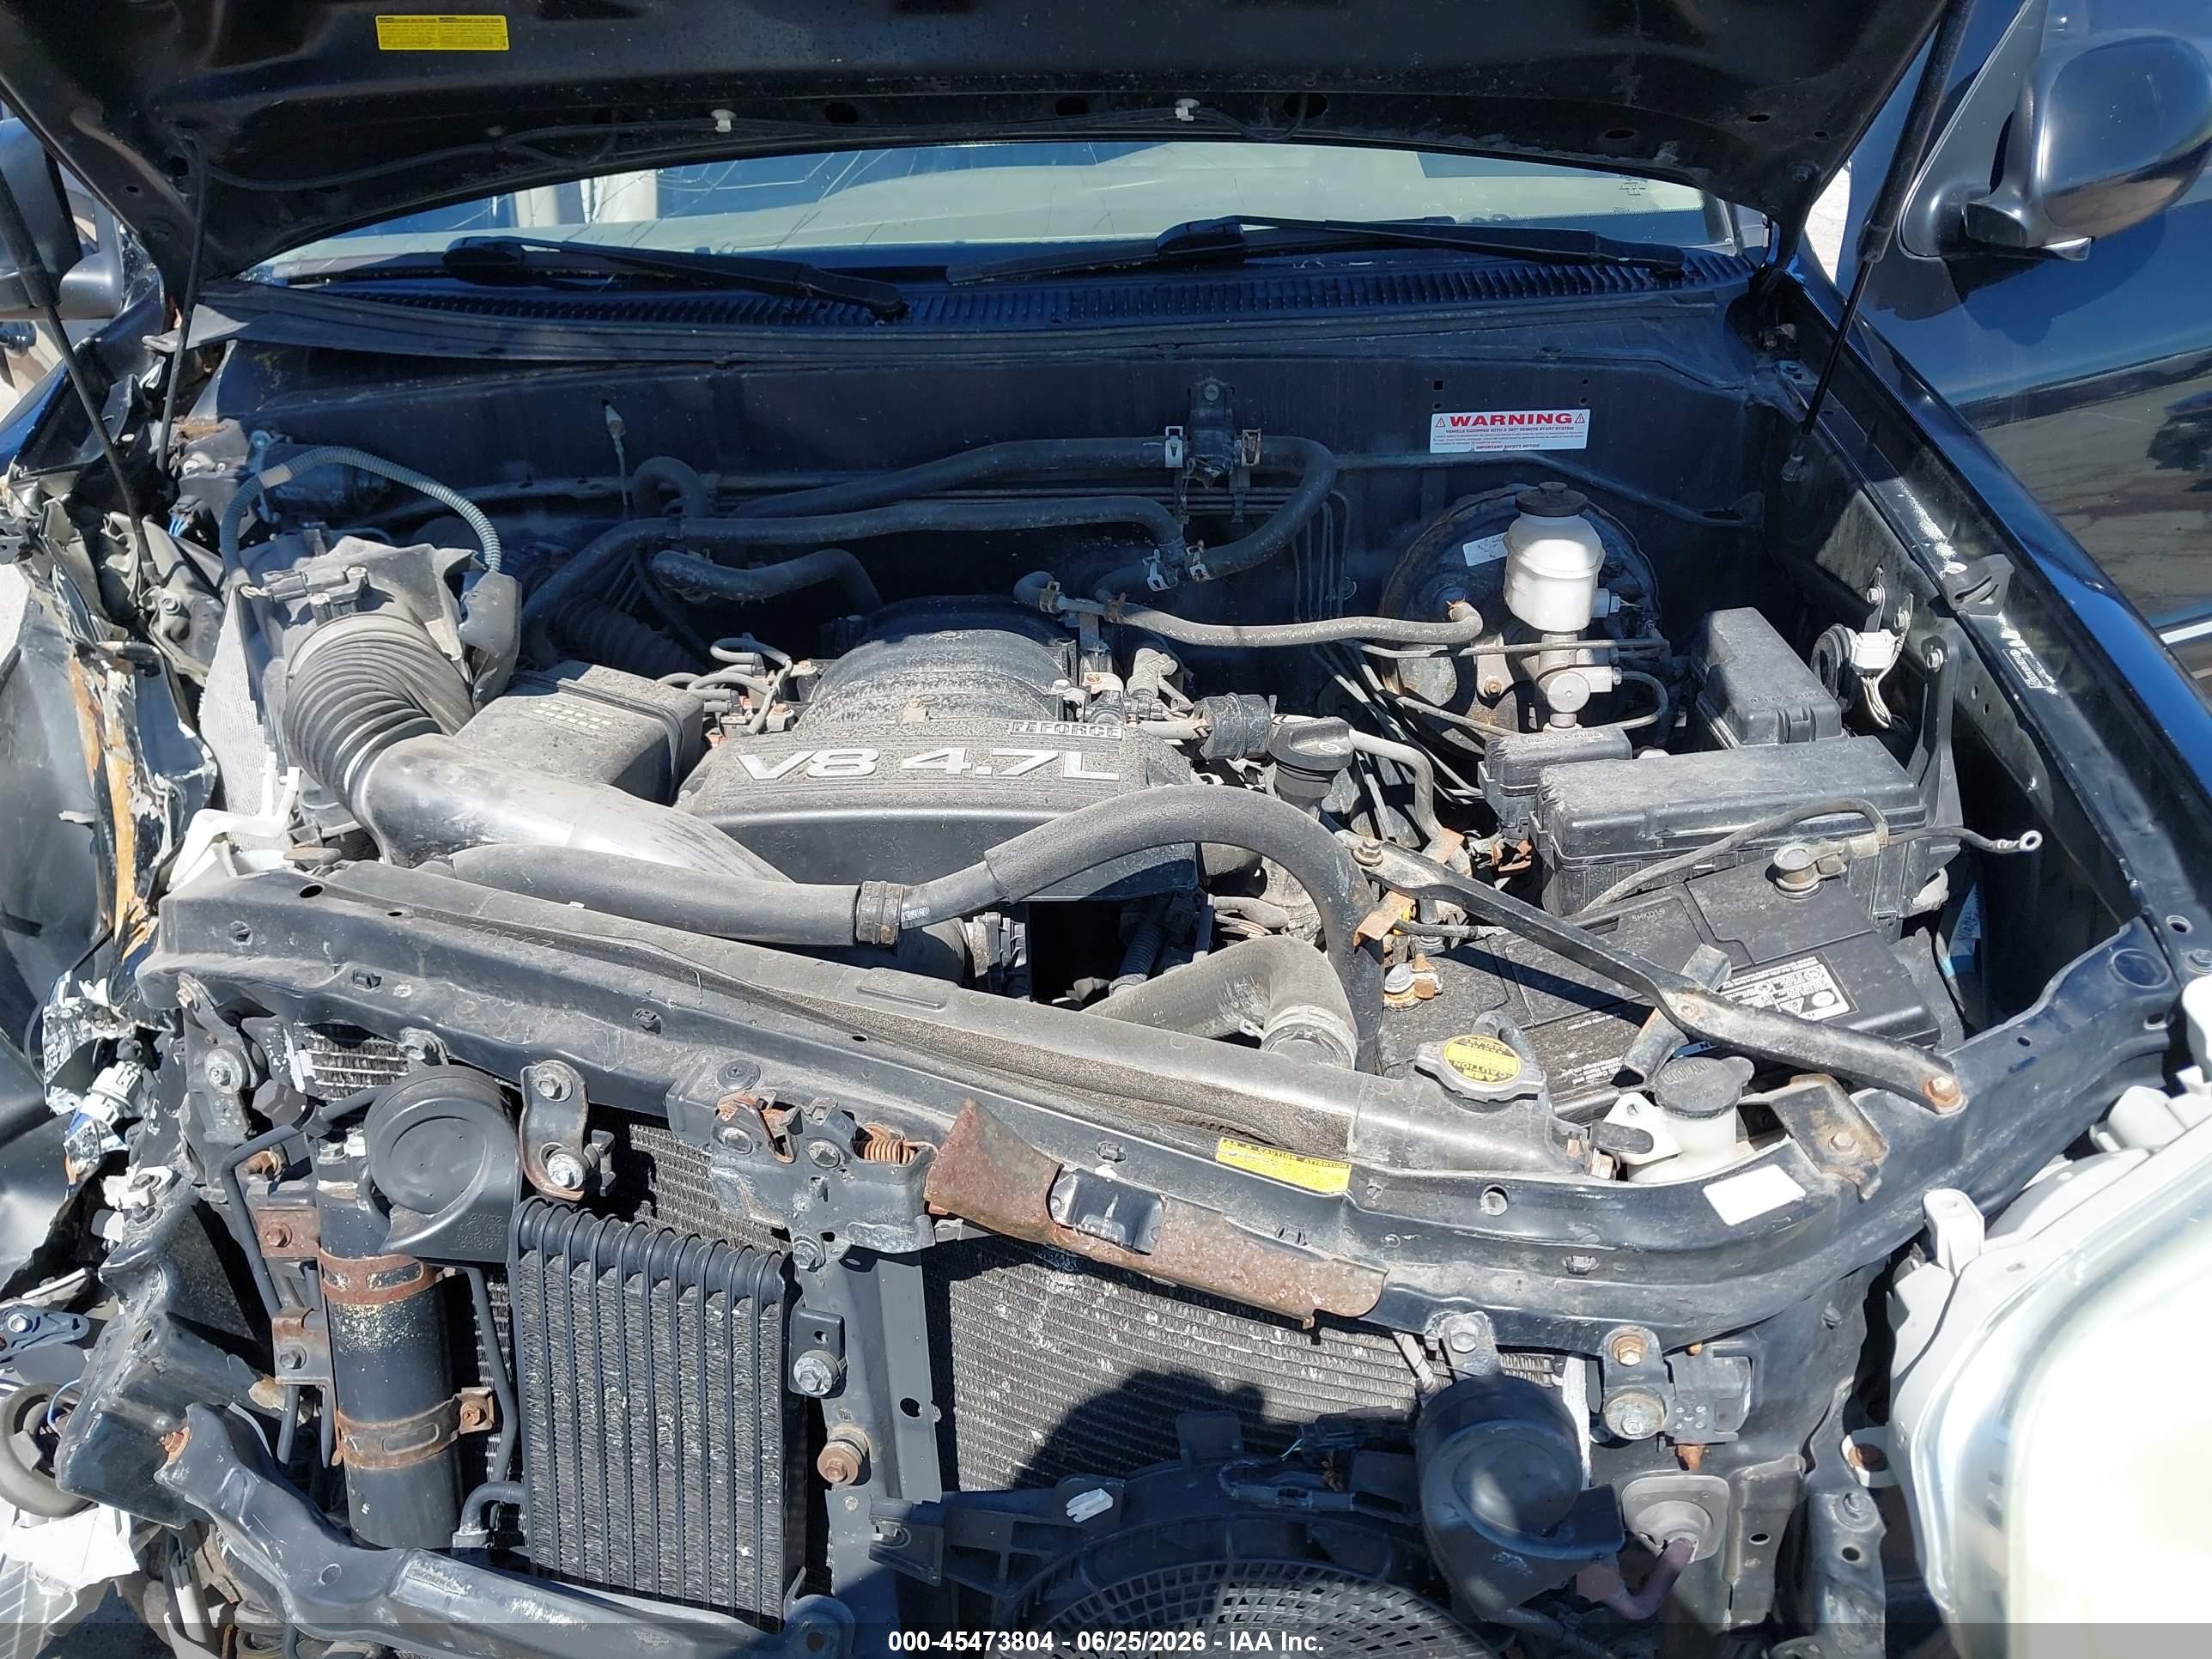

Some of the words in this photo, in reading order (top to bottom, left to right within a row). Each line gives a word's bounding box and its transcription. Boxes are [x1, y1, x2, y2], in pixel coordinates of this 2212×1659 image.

[1449, 413, 1572, 427] WARNING
[1040, 721, 1121, 738] FORCE
[736, 747, 880, 781] V8
[900, 747, 1121, 782] 4.7L
[1454, 1060, 1508, 1078] CAUTION
[1662, 1061, 1711, 1085] COOLANT
[1258, 1147, 1297, 1161] CAUTION
